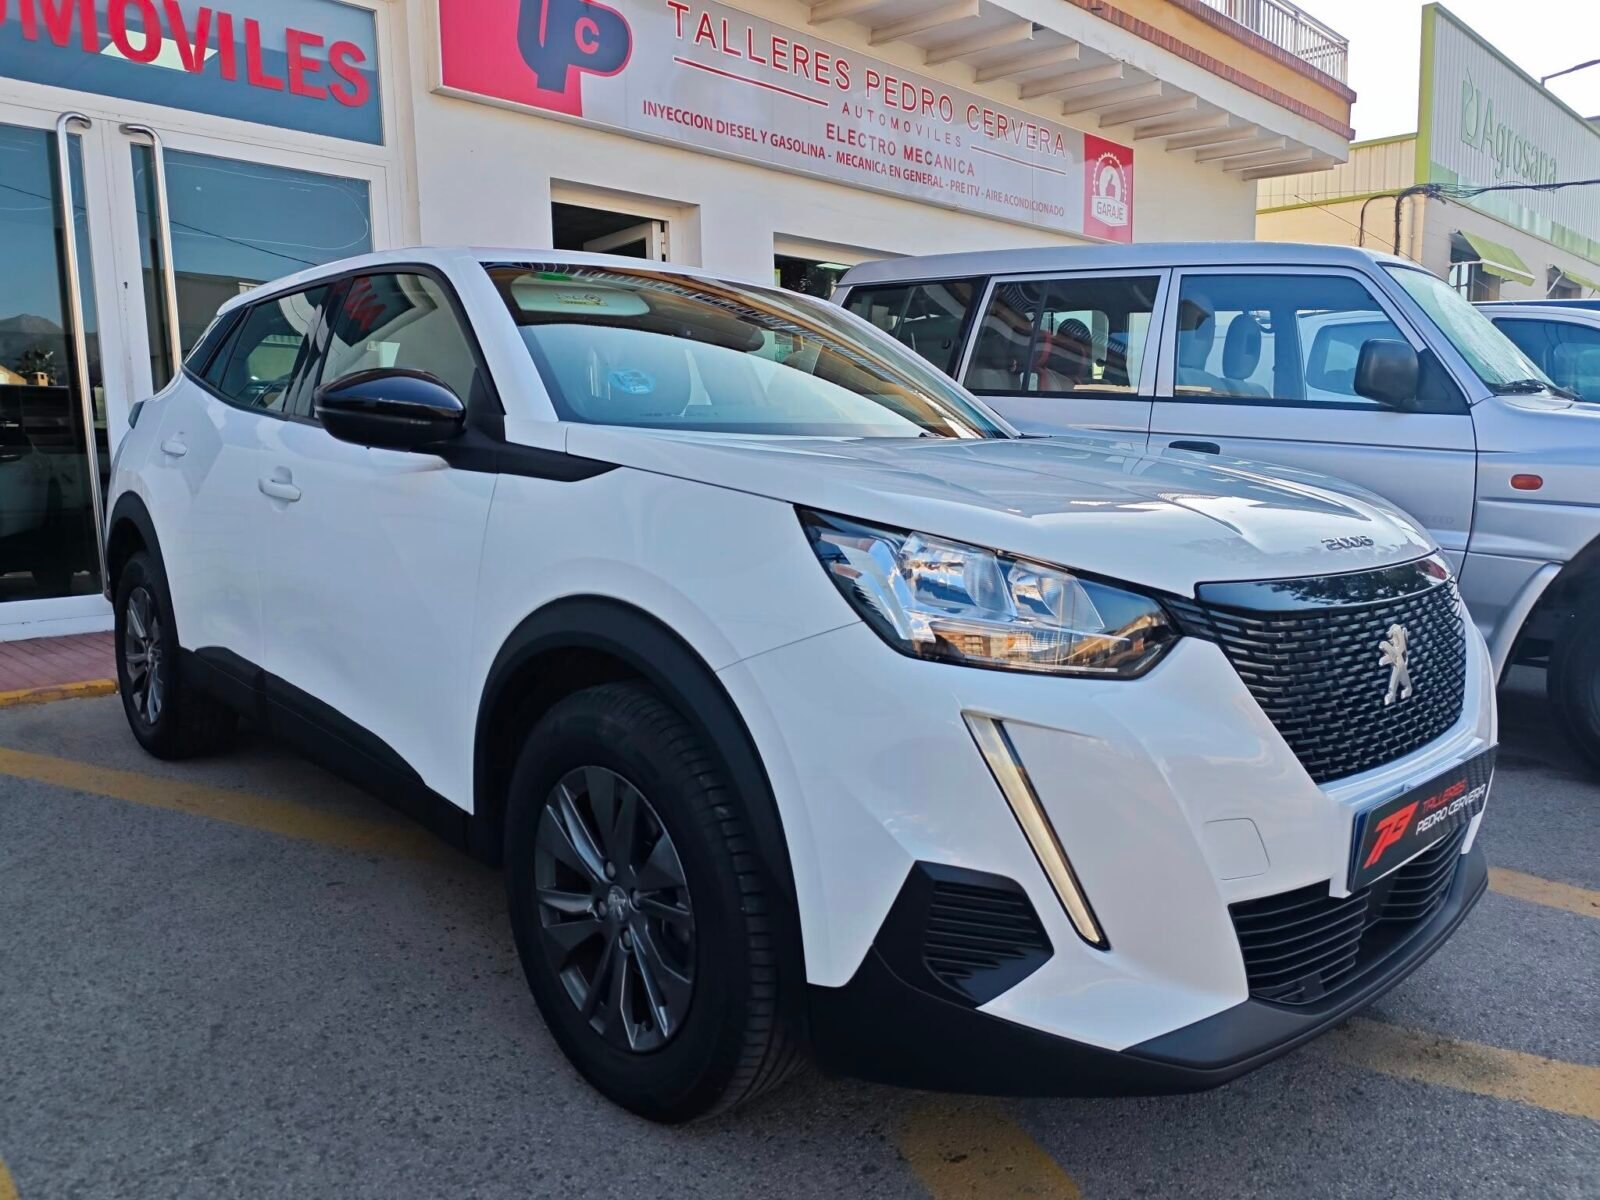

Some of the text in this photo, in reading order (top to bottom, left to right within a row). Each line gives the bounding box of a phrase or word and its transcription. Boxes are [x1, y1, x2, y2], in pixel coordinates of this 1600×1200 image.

[0, 0, 370, 107] MOVILES
[667, 0, 1067, 157] TALLERES PEDRO CERVERA
[826, 122, 975, 177] ELECTRO MECANICA
[842, 102, 961, 148] AUTOMOVILES
[1481, 97, 1557, 184] Agrosana
[642, 99, 713, 132] INYECCION
[716, 119, 758, 142] DIESEL
[760, 130, 768, 144] Y
[770, 133, 826, 160] GASOLINA
[836, 151, 887, 175] MECANICA
[889, 164, 901, 180] EN
[902, 168, 944, 189] GENERAL
[950, 179, 966, 194] PRE
[966, 182, 980, 197] ITV
[985, 188, 1003, 203] AIRE
[1003, 193, 1065, 217] ACONDICIONADO
[1096, 201, 1124, 221] GARAJE
[1415, 783, 1486, 836] PEDRO CERVERA
[1422, 777, 1467, 812] TALLERES
